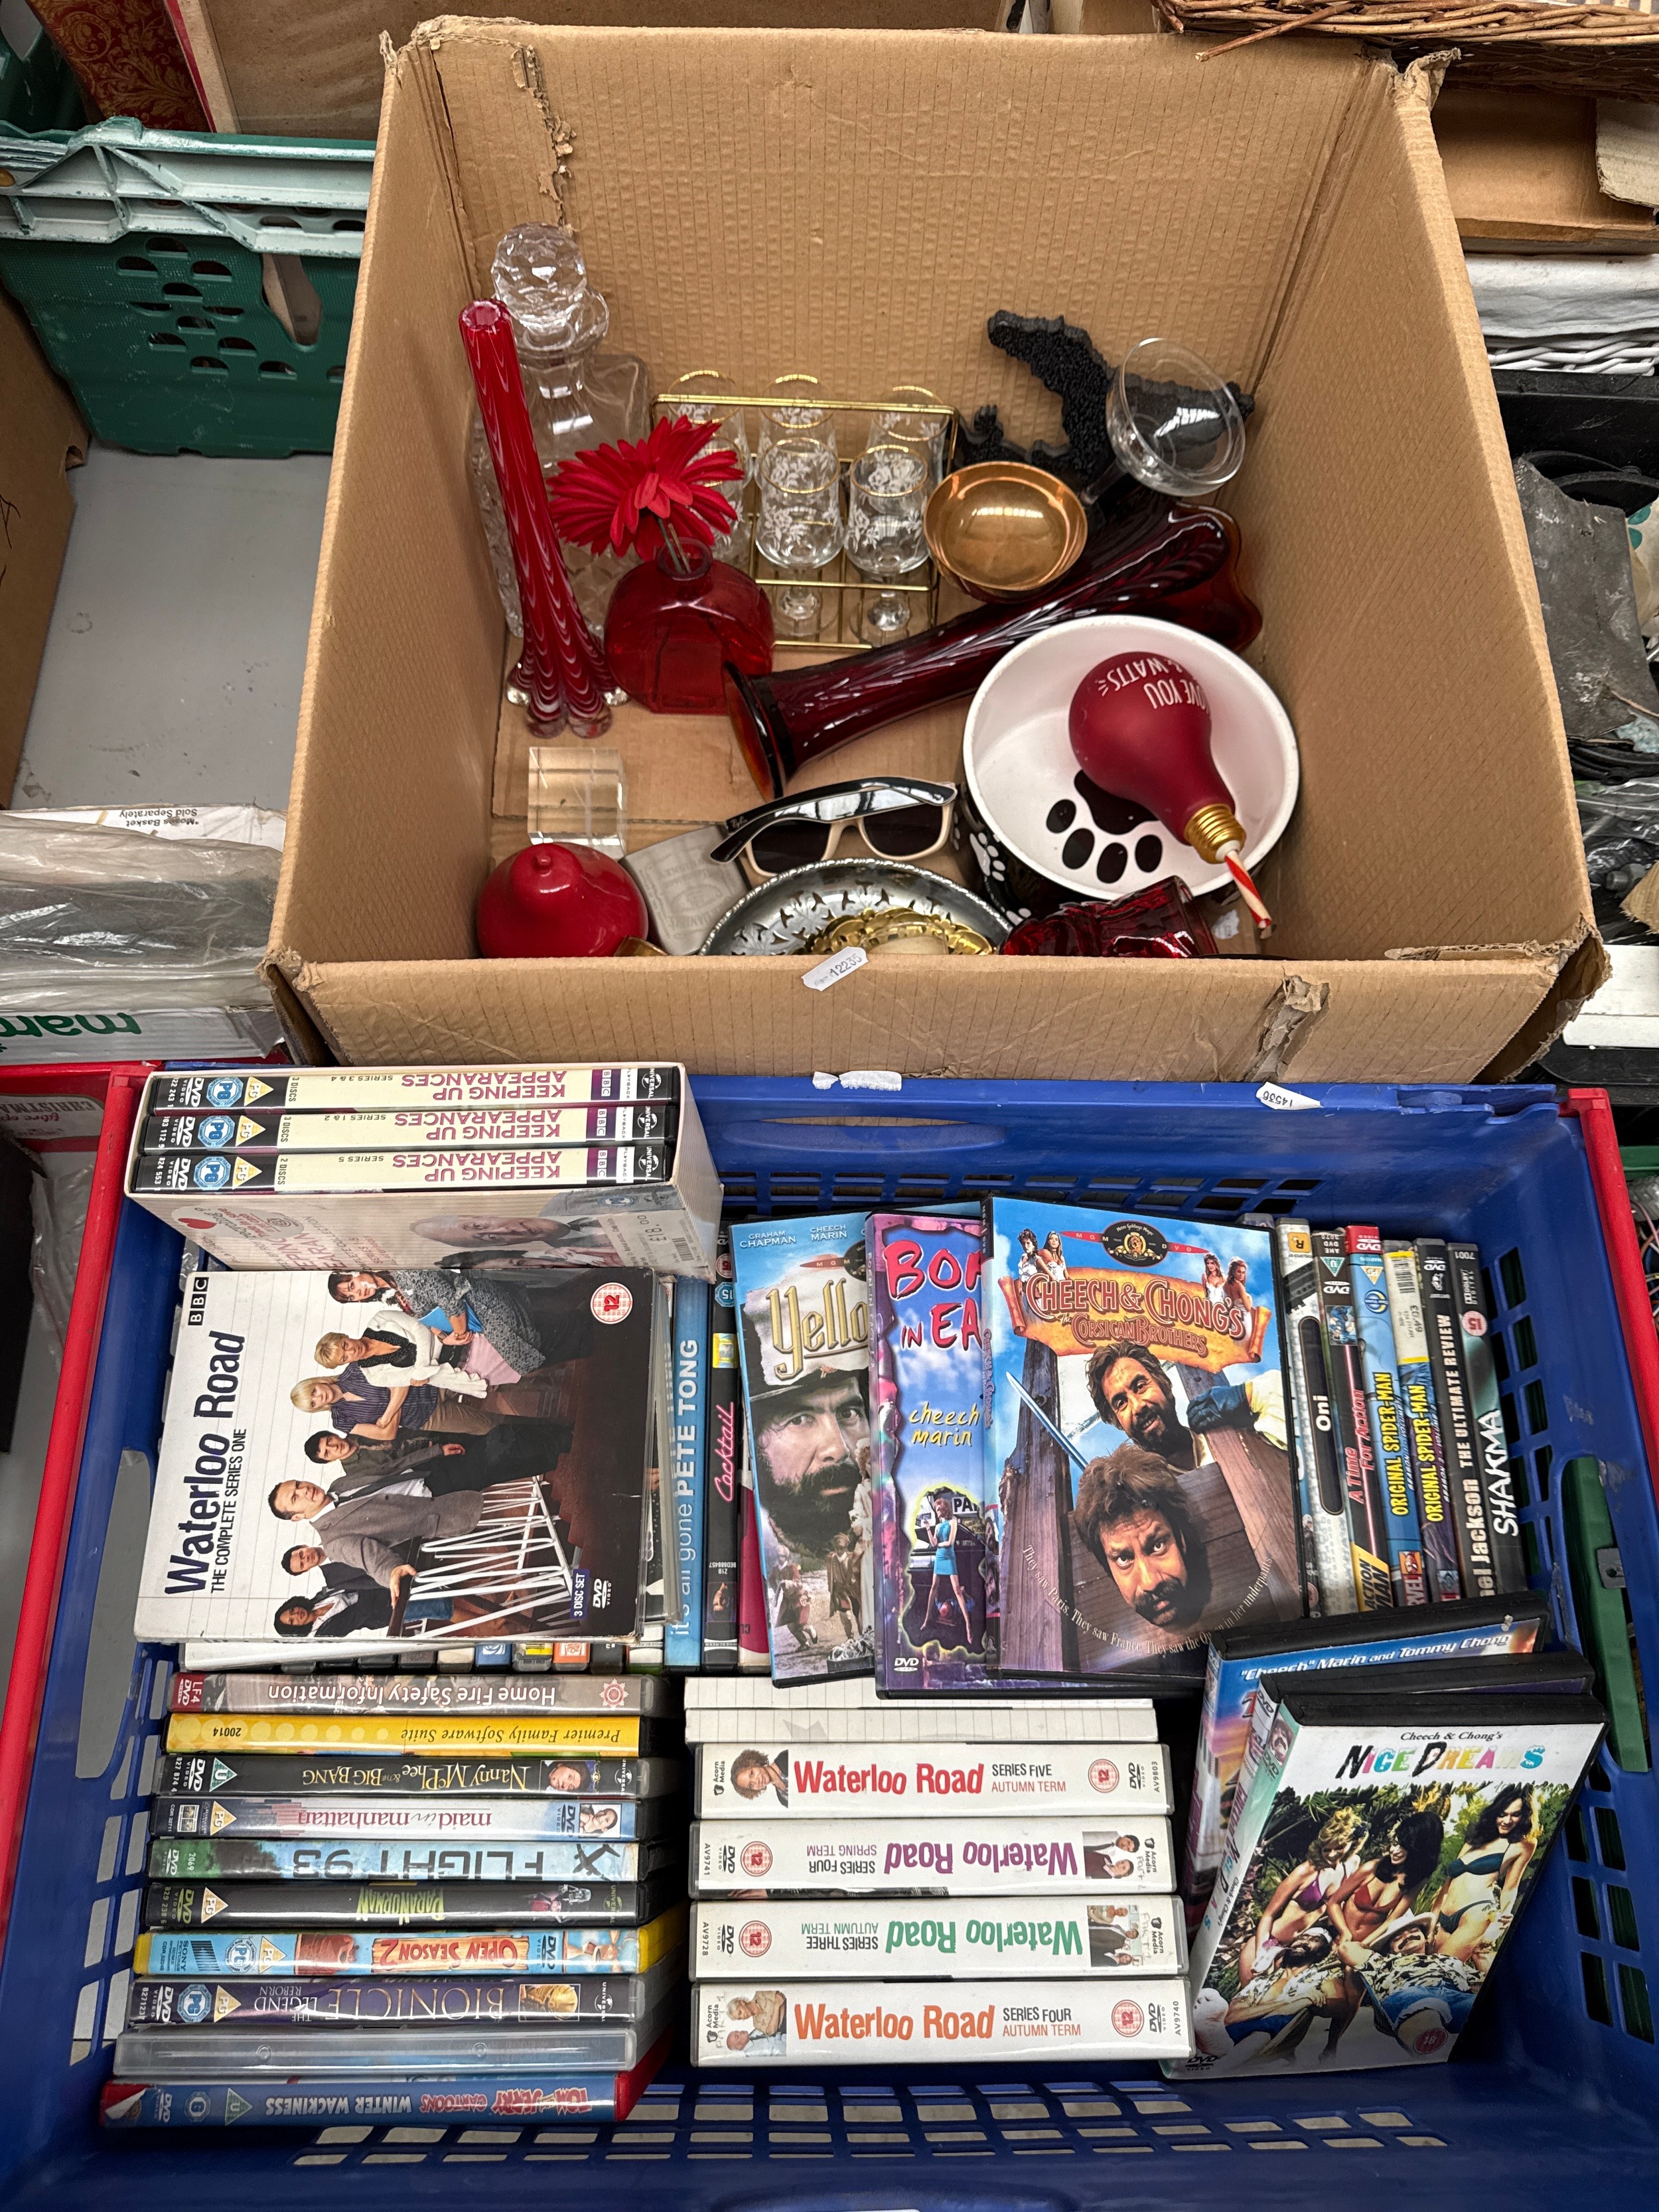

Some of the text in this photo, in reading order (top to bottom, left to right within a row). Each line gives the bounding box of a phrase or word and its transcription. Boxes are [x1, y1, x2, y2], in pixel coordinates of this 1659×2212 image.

[1106, 657, 1169, 692] WATTS
[1143, 677, 1183, 709] YOU
[119, 808, 198, 820] Sold Separately
[125, 818, 161, 828] Basket
[830, 953, 863, 978] 12235
[401, 1070, 568, 1087] APPEARANCES
[288, 1082, 299, 1102] DISCS
[432, 1084, 566, 1101] KEEPING UP
[394, 1109, 563, 1127] APPEARANCES
[425, 1124, 561, 1141] KEEPING UP
[392, 1150, 563, 1168] APPEARANCES
[425, 1165, 561, 1183] KEEPING UP
[739, 1236, 797, 1248] CHAPMAN
[810, 1230, 847, 1242] MARIN
[749, 1224, 847, 1240] GRAHAM CHEECH
[603, 1294, 620, 1312] 12
[1026, 1273, 1246, 1340] CHEECH & CHONG'S
[1056, 1312, 1072, 1325] The
[1071, 1312, 1208, 1358] CORSICAN BROTHERS
[1436, 1314, 1460, 1373] REVIEW
[678, 1339, 699, 1416] TONG
[908, 1401, 980, 1426] cheech
[1313, 1395, 1332, 1432] Oni
[1444, 1370, 1471, 1438] ULTIMATE
[911, 1428, 974, 1448] marin
[1352, 1389, 1375, 1471] For Action
[713, 1400, 737, 1502] Cocktail
[1373, 1372, 1409, 1516] ORIGINAL SPIDER-MAN
[1407, 1384, 1445, 1523] ORIGINAL SPIDER-MAN
[1456, 1441, 1475, 1469] THE
[163, 1329, 246, 1594] Waterloo Road
[676, 1425, 696, 1497] PETE
[1478, 1410, 1520, 1537] SHAKMA
[1345, 1447, 1364, 1505] A Time
[210, 1428, 248, 1593] THE COMPLETE SERIES ONE
[1462, 1479, 1492, 1564] Jackson
[678, 1502, 697, 1562] gone
[575, 1572, 586, 1589] SET
[1359, 1558, 1376, 1611] ACTION
[573, 1589, 585, 1609] DISC
[1022, 1544, 1039, 1572] They
[1034, 1569, 1050, 1590] saw
[1047, 1585, 1071, 1617] Paris.
[1070, 1609, 1092, 1635] They
[1091, 1626, 1110, 1641] saw
[1110, 1631, 1145, 1653] France.
[1145, 1640, 1167, 1659] They
[1167, 1642, 1185, 1654] saw
[1185, 1636, 1199, 1651] the
[1232, 1605, 1247, 1622] her
[1316, 1653, 1367, 1670] Marin
[1369, 1651, 1396, 1663] and
[1398, 1641, 1457, 1660] Tommy
[1460, 1633, 1511, 1651] Chong
[268, 1681, 556, 1706] Home Fire Safety Information
[212, 1727, 243, 1737] 20014
[400, 1726, 622, 1743] Premier Family Software Suite
[1400, 1730, 1504, 1742] Cheech & Chong's
[991, 1763, 1052, 1777] SERIES FIVE
[1334, 1742, 1417, 1781] NICE
[301, 1765, 353, 1786] BANG
[352, 1767, 386, 1787] BIG
[401, 1761, 469, 1791] McPhee
[469, 1763, 533, 1792] Nanny
[793, 1760, 984, 1795] Waterloo Road
[991, 1780, 1066, 1793] AUTUMN TERM
[298, 1811, 411, 1830] manhattan
[438, 1812, 494, 1832] maid
[806, 1844, 877, 1857] SPRING TERM
[883, 1841, 1078, 1876] Waterloo Road
[293, 1849, 545, 1881] FLIGHT 93
[808, 1860, 876, 1875] SERIES FOUR
[800, 1922, 879, 1935] AUTUMN TERM
[885, 1919, 1084, 1956] Waterloo Road
[180, 1940, 189, 1972] SONY
[398, 1939, 463, 1968] SEASON
[465, 1937, 518, 1968] OPEN
[806, 1935, 879, 1951] SERIES THREE
[259, 1984, 303, 1996] REBORN
[253, 1996, 319, 2023] THE LEGEND
[325, 1986, 505, 2023] BIONICLE
[1003, 2006, 1072, 2023] SERIES FOUR
[794, 2003, 995, 2041] Waterloo Road
[1002, 2024, 1082, 2037] AUTUMN TERM
[265, 2095, 351, 2116] WACKINESS
[354, 2094, 413, 2115] WINTER
[419, 2093, 489, 2114] CARTOONS
[490, 2087, 543, 2117] JERRY
[553, 2087, 594, 2116] TOM
